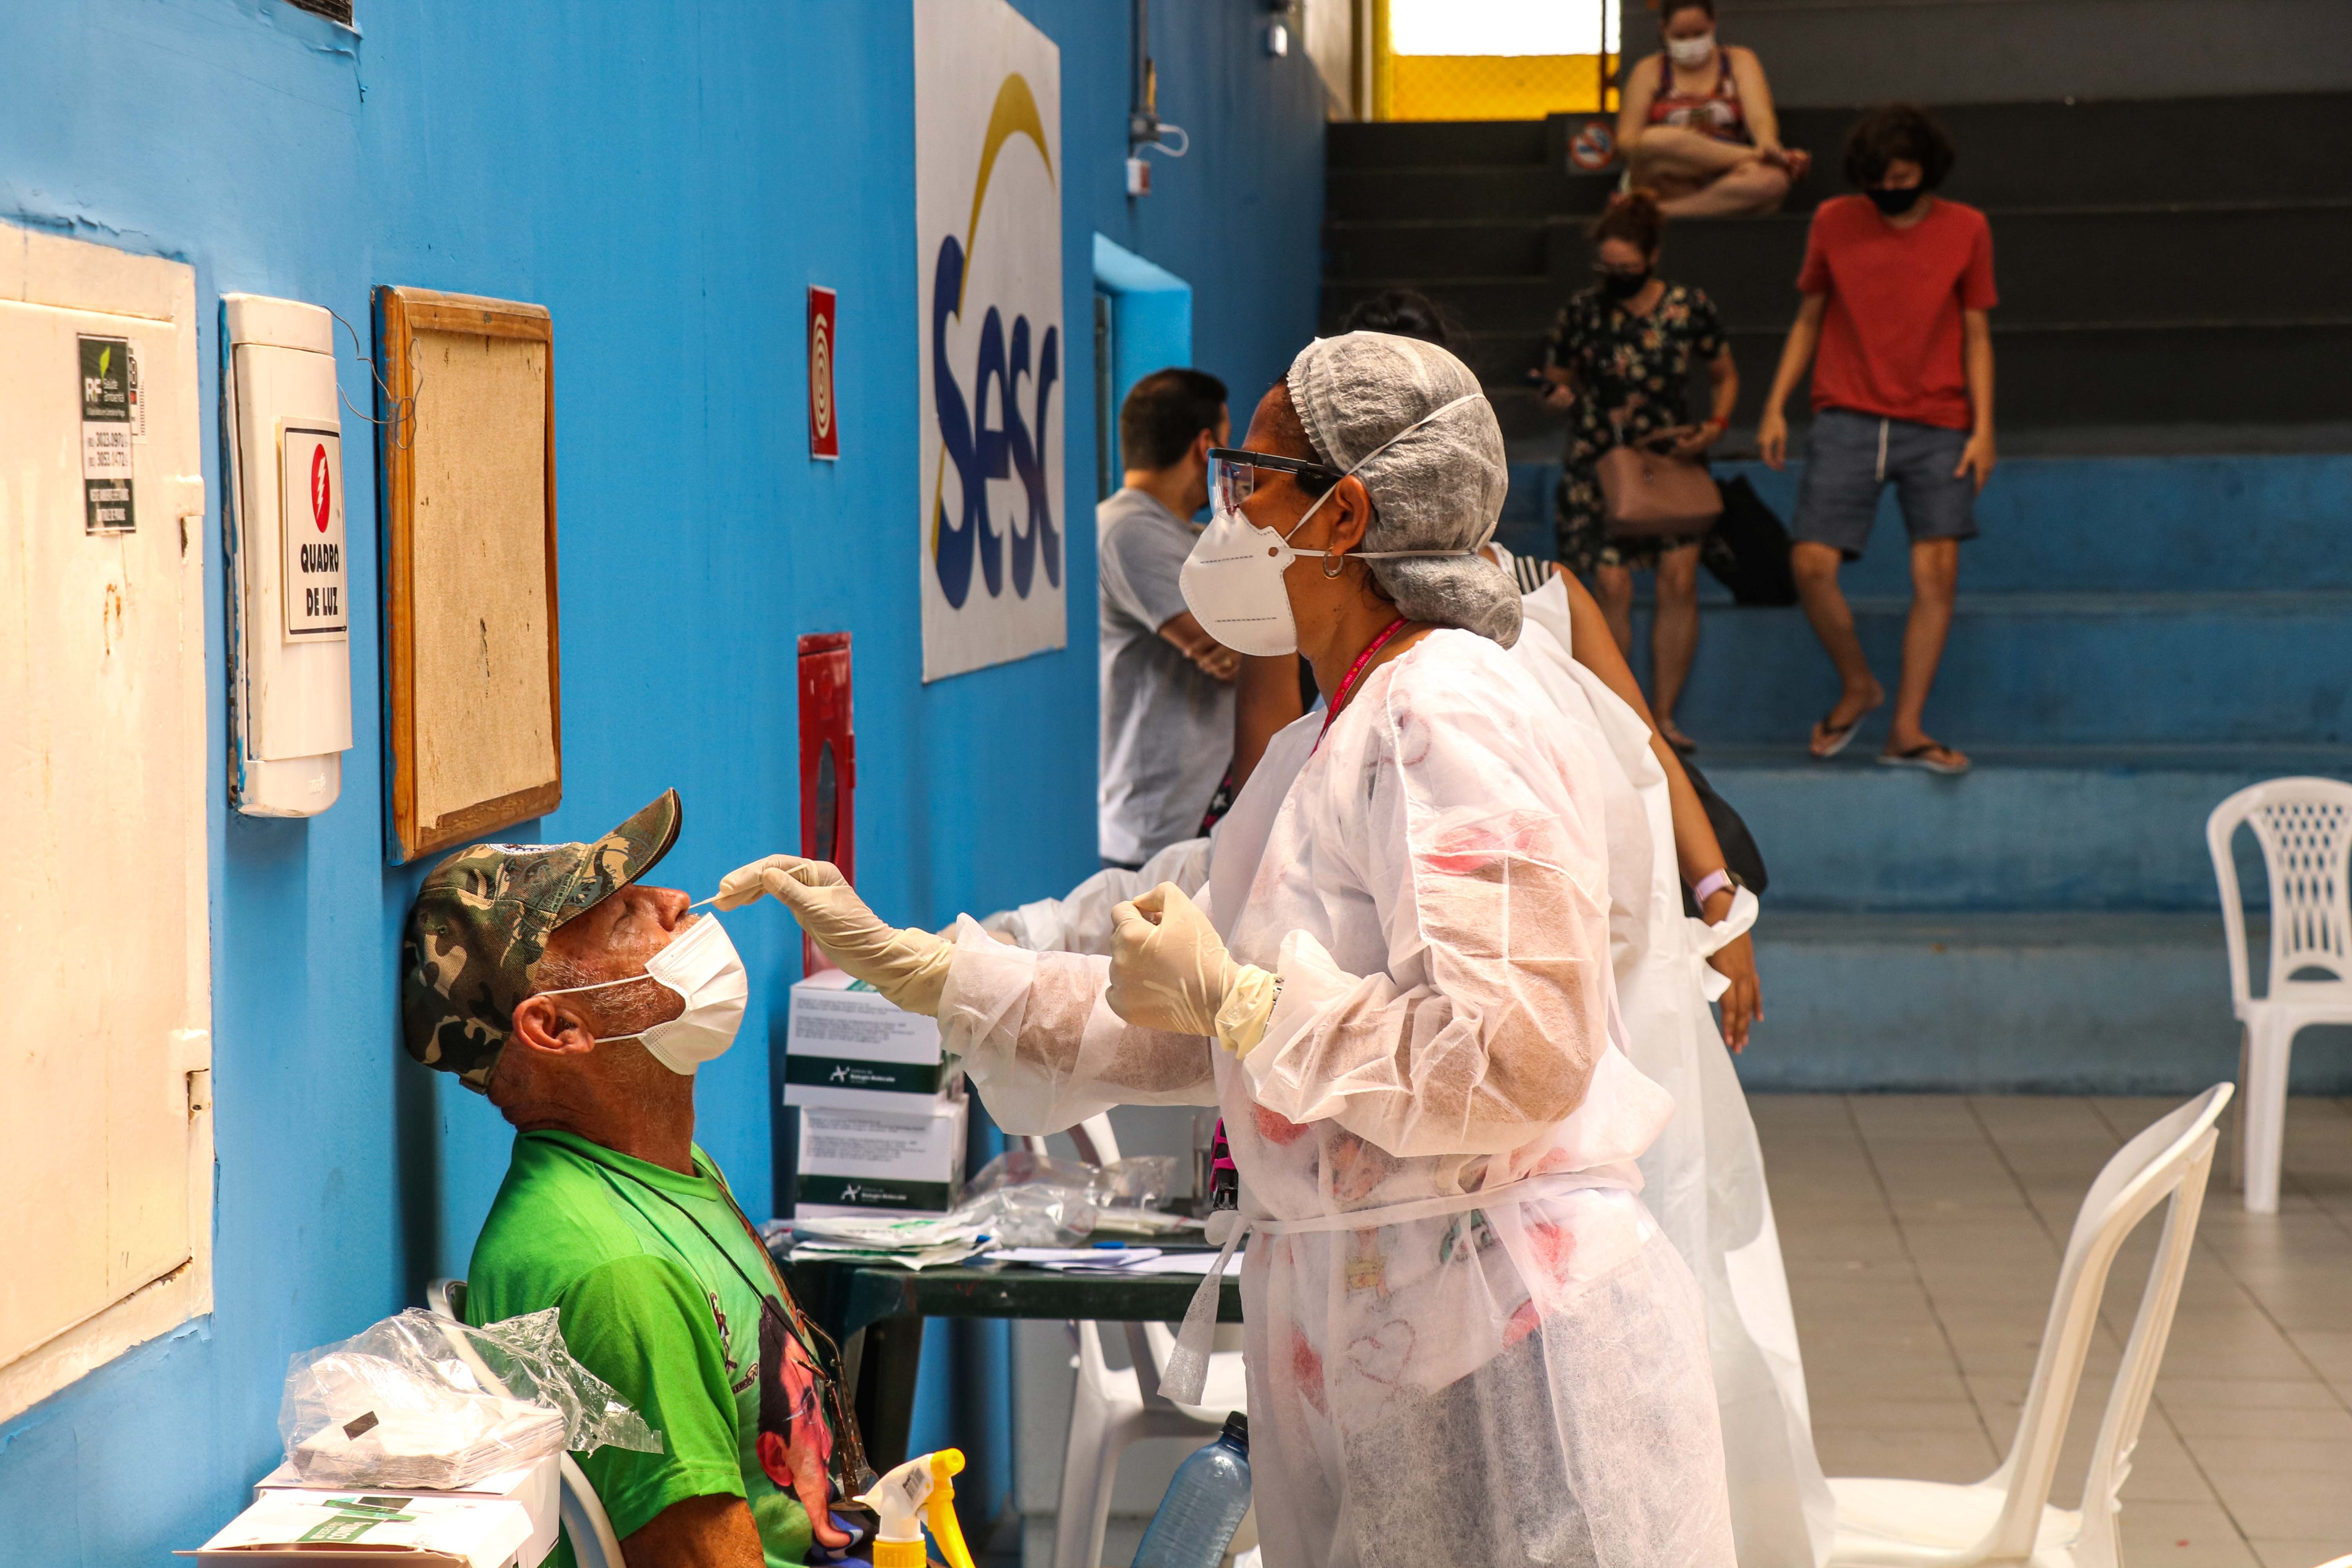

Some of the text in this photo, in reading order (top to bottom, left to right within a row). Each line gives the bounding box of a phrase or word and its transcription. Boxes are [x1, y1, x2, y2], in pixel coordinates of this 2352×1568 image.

[85, 377, 102, 402] RF
[933, 234, 1060, 610] Sesc
[301, 543, 339, 574] QUADRO
[306, 587, 338, 617] DE LUZ
